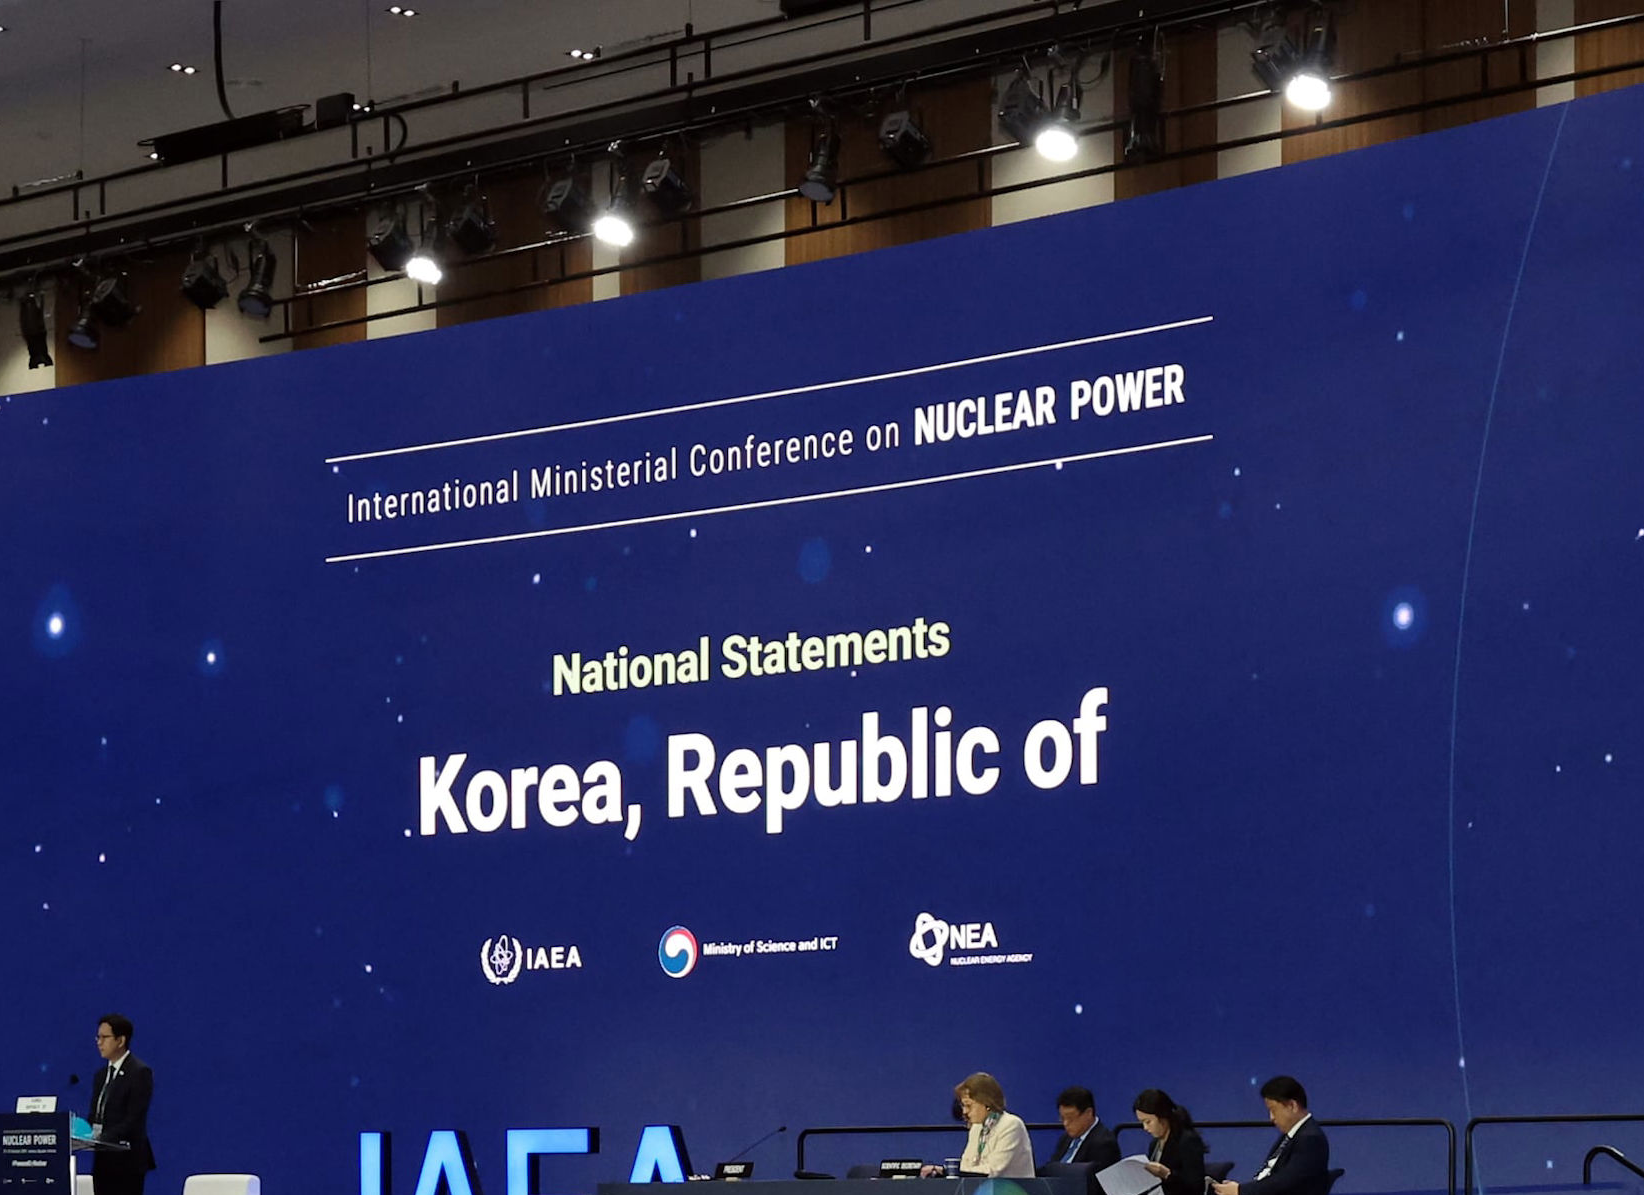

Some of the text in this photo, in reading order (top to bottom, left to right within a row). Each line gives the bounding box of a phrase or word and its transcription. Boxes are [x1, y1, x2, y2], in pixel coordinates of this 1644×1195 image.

[346, 363, 1186, 524] International Ministerial Conference on NUCLEAR POWER
[552, 616, 951, 696] National Statements
[418, 686, 1109, 841] Korea, Republic of
[703, 936, 838, 957] Ministry of Science and ICT
[950, 922, 998, 950] NEA
[526, 945, 583, 970] IAEA
[2, 1134, 57, 1146] NUCLEAR POWER
